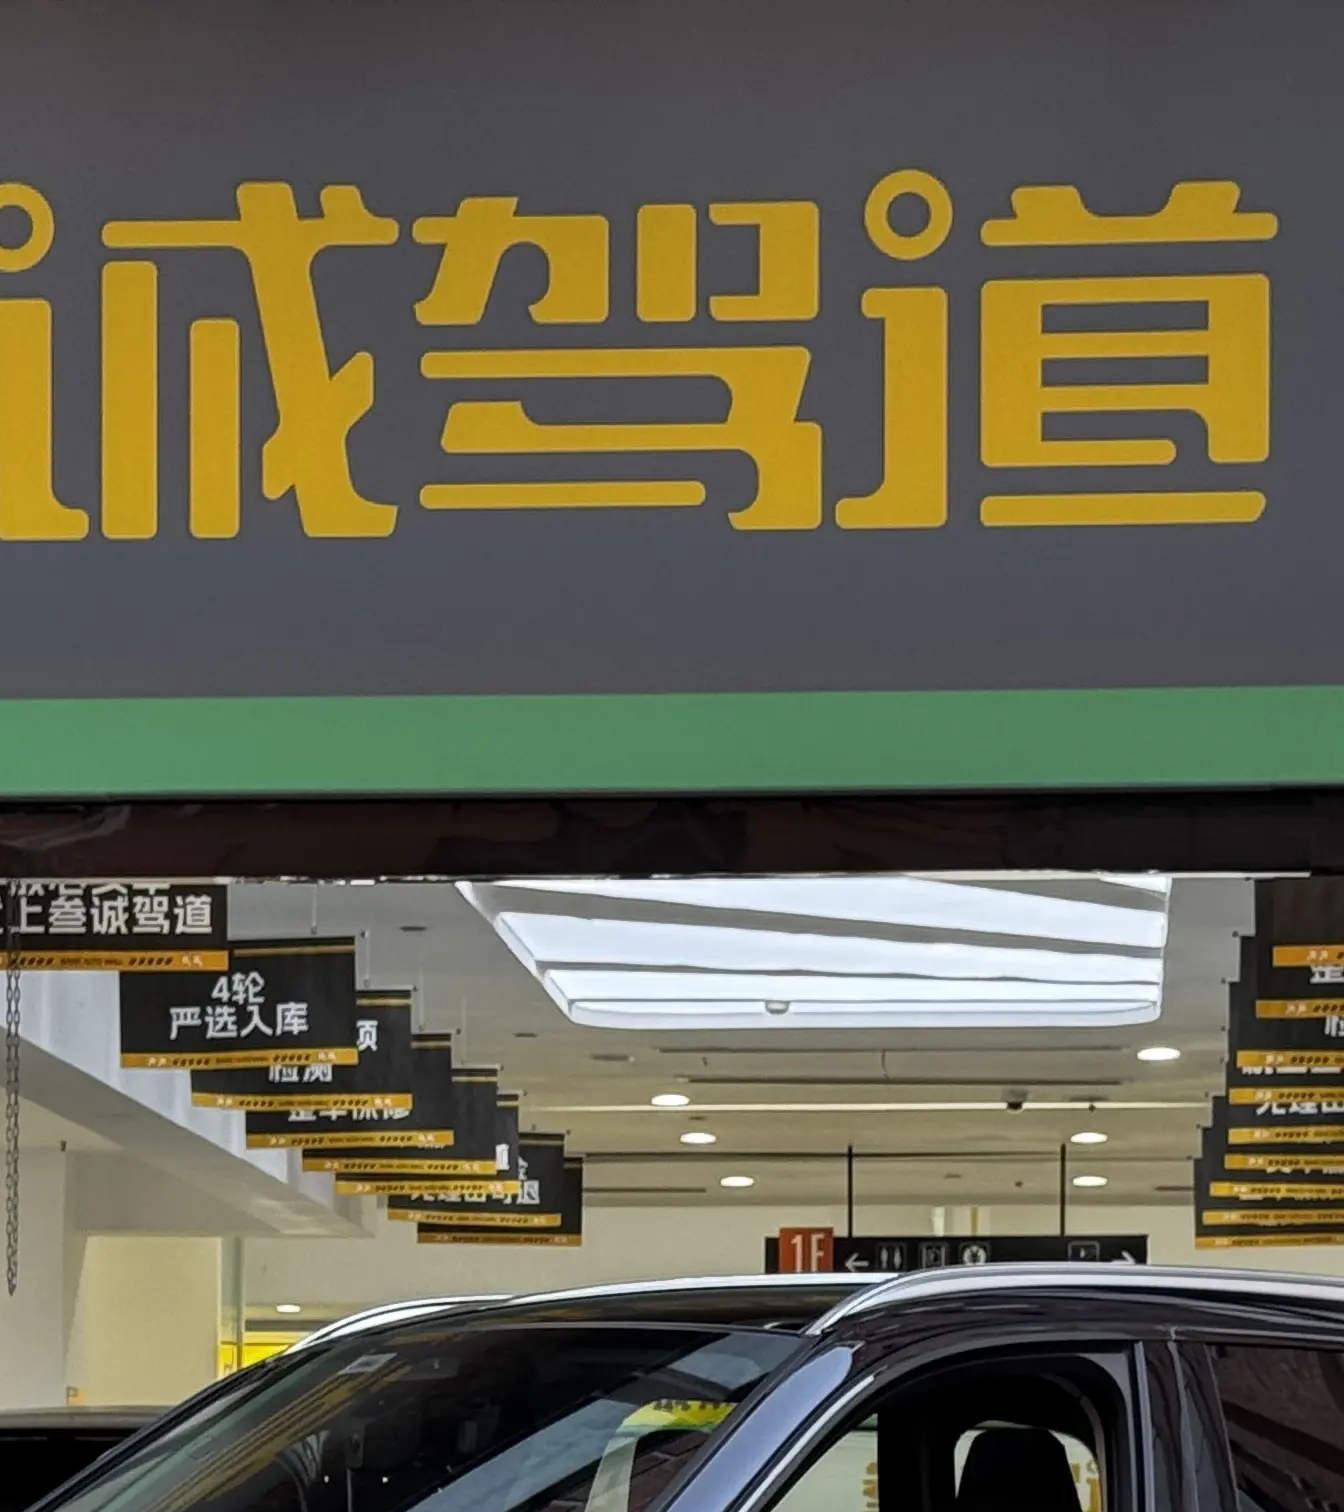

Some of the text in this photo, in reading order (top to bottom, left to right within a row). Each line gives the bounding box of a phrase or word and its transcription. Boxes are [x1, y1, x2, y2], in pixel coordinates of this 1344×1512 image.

[212, 971, 265, 1005] 4轮
[169, 1001, 309, 1040] 严选入库
[789, 1232, 825, 1273] 1F
